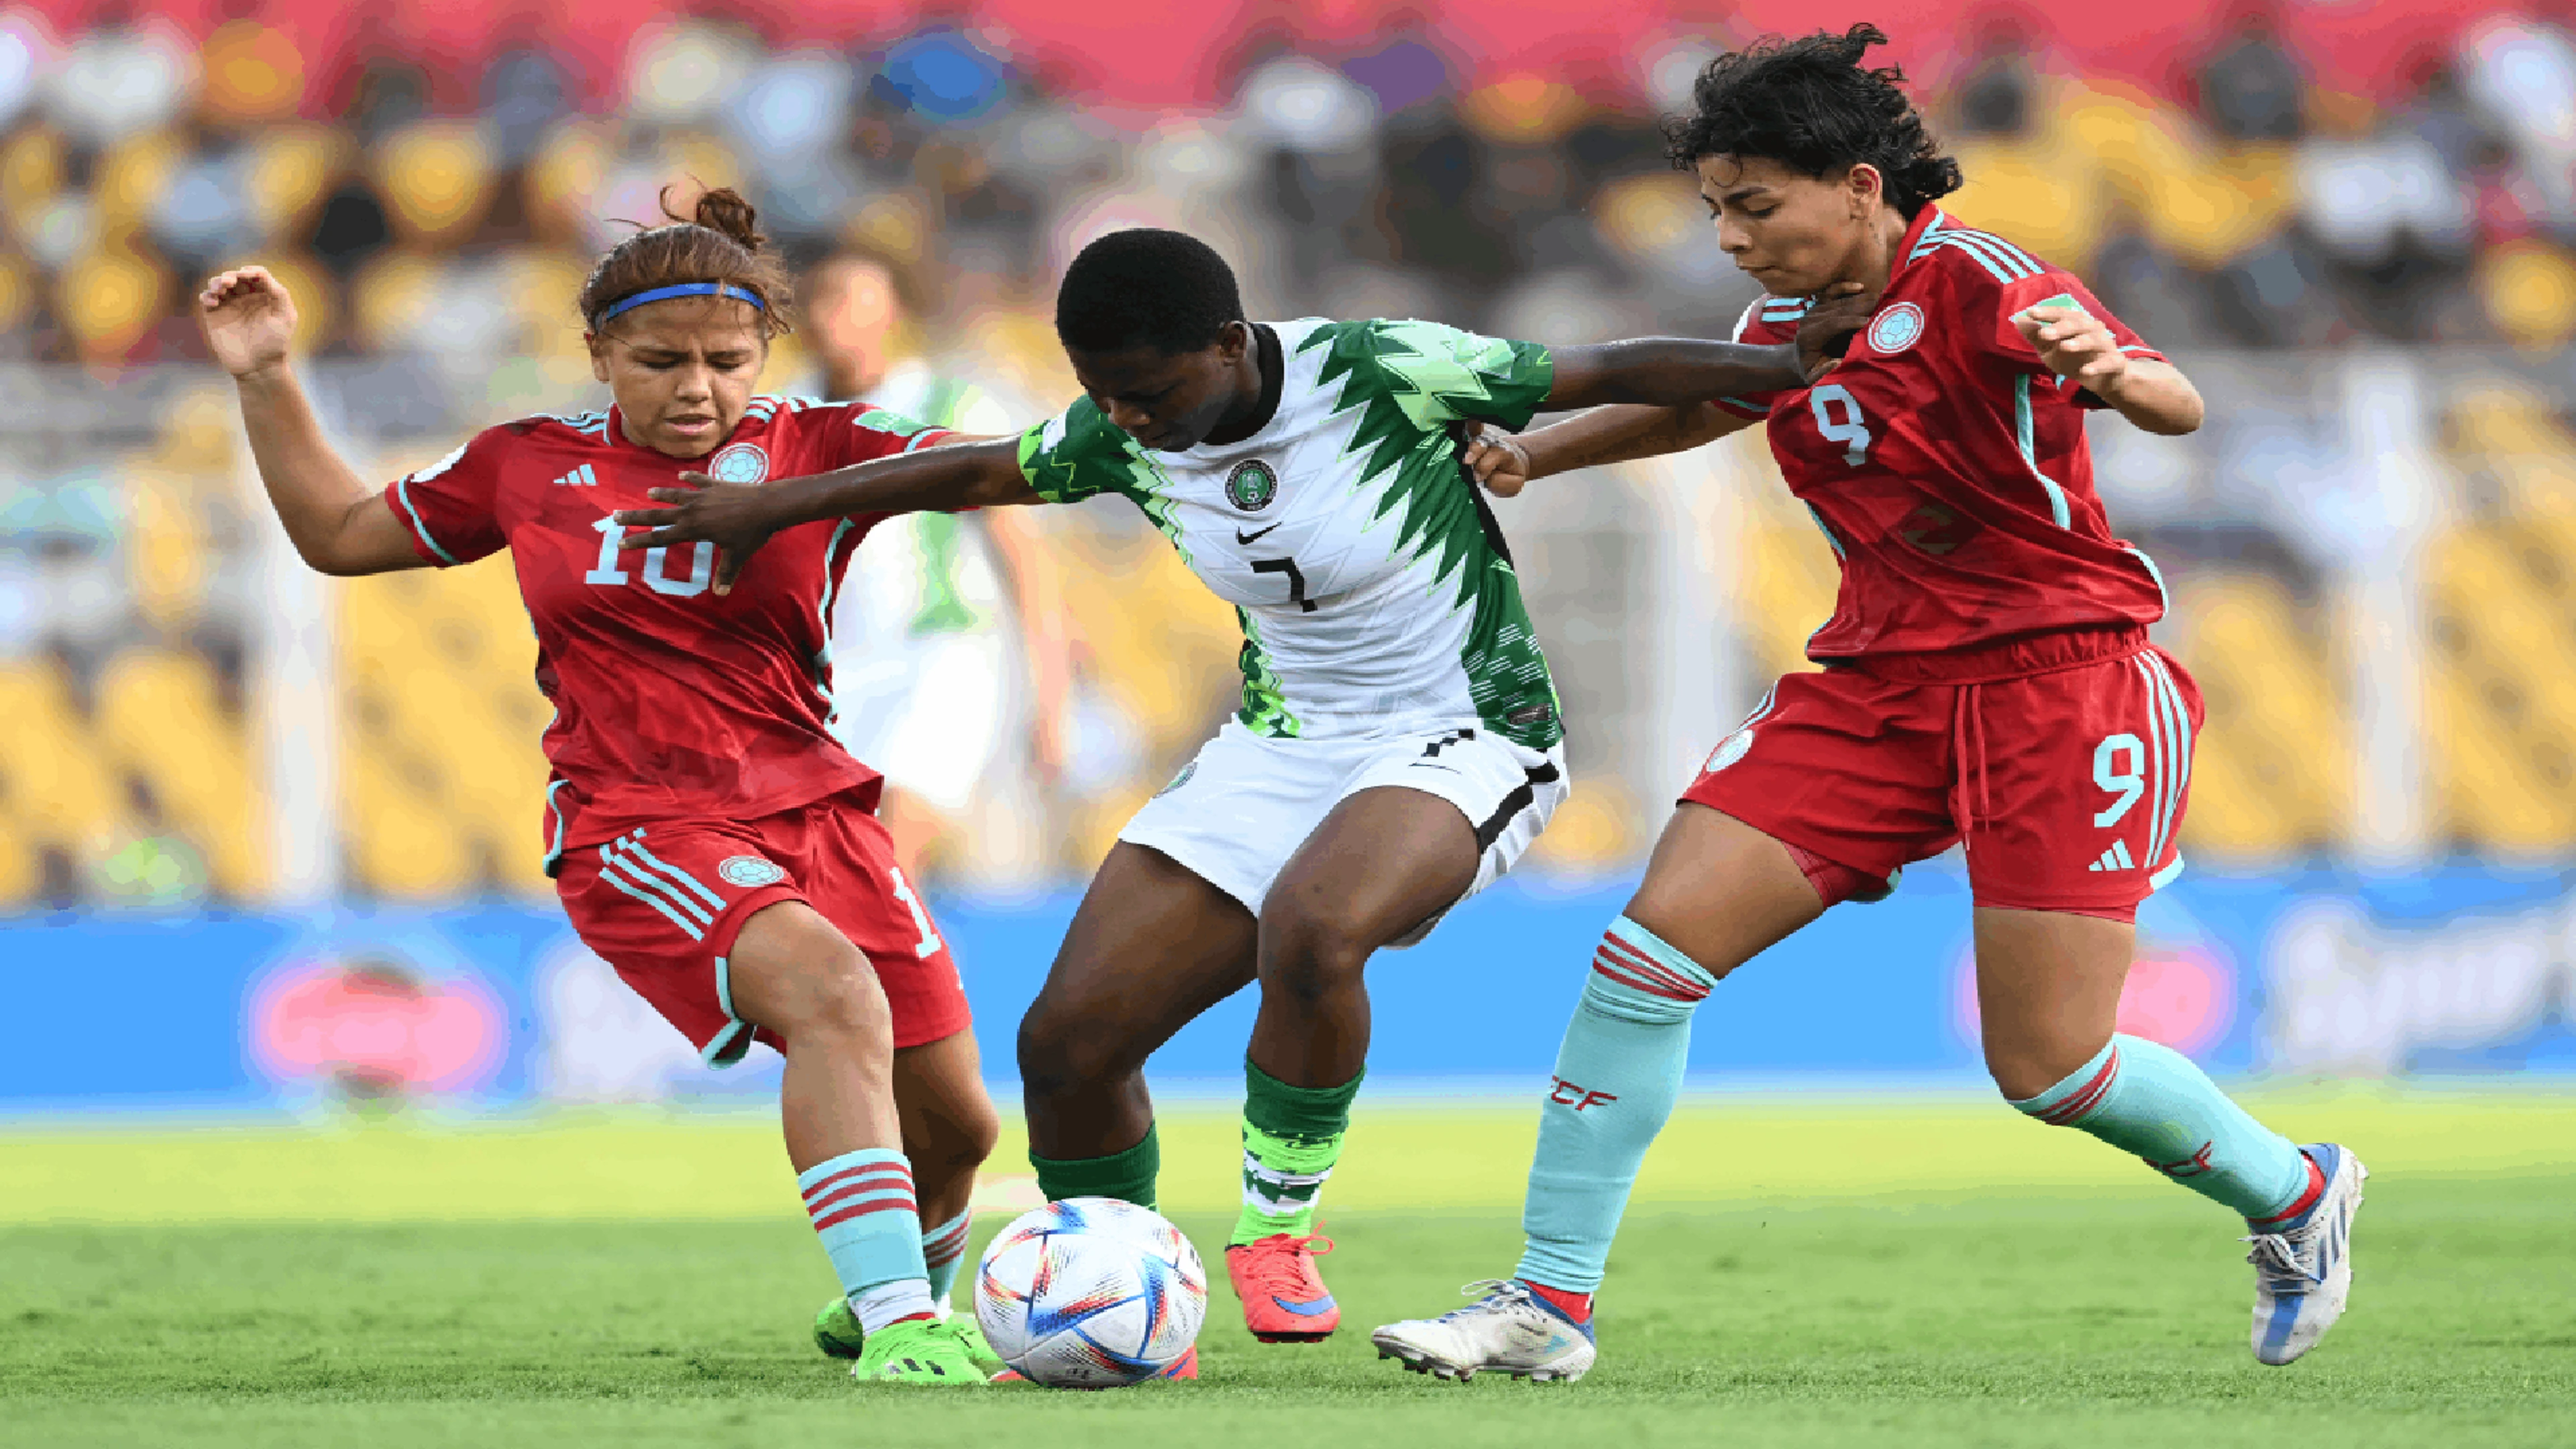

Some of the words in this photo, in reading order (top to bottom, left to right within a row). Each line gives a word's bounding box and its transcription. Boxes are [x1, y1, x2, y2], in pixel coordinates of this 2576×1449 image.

[1809, 384, 1872, 468] 9
[584, 515, 714, 597] 10
[1250, 556, 1318, 612] 7
[2092, 733, 2145, 828] 9
